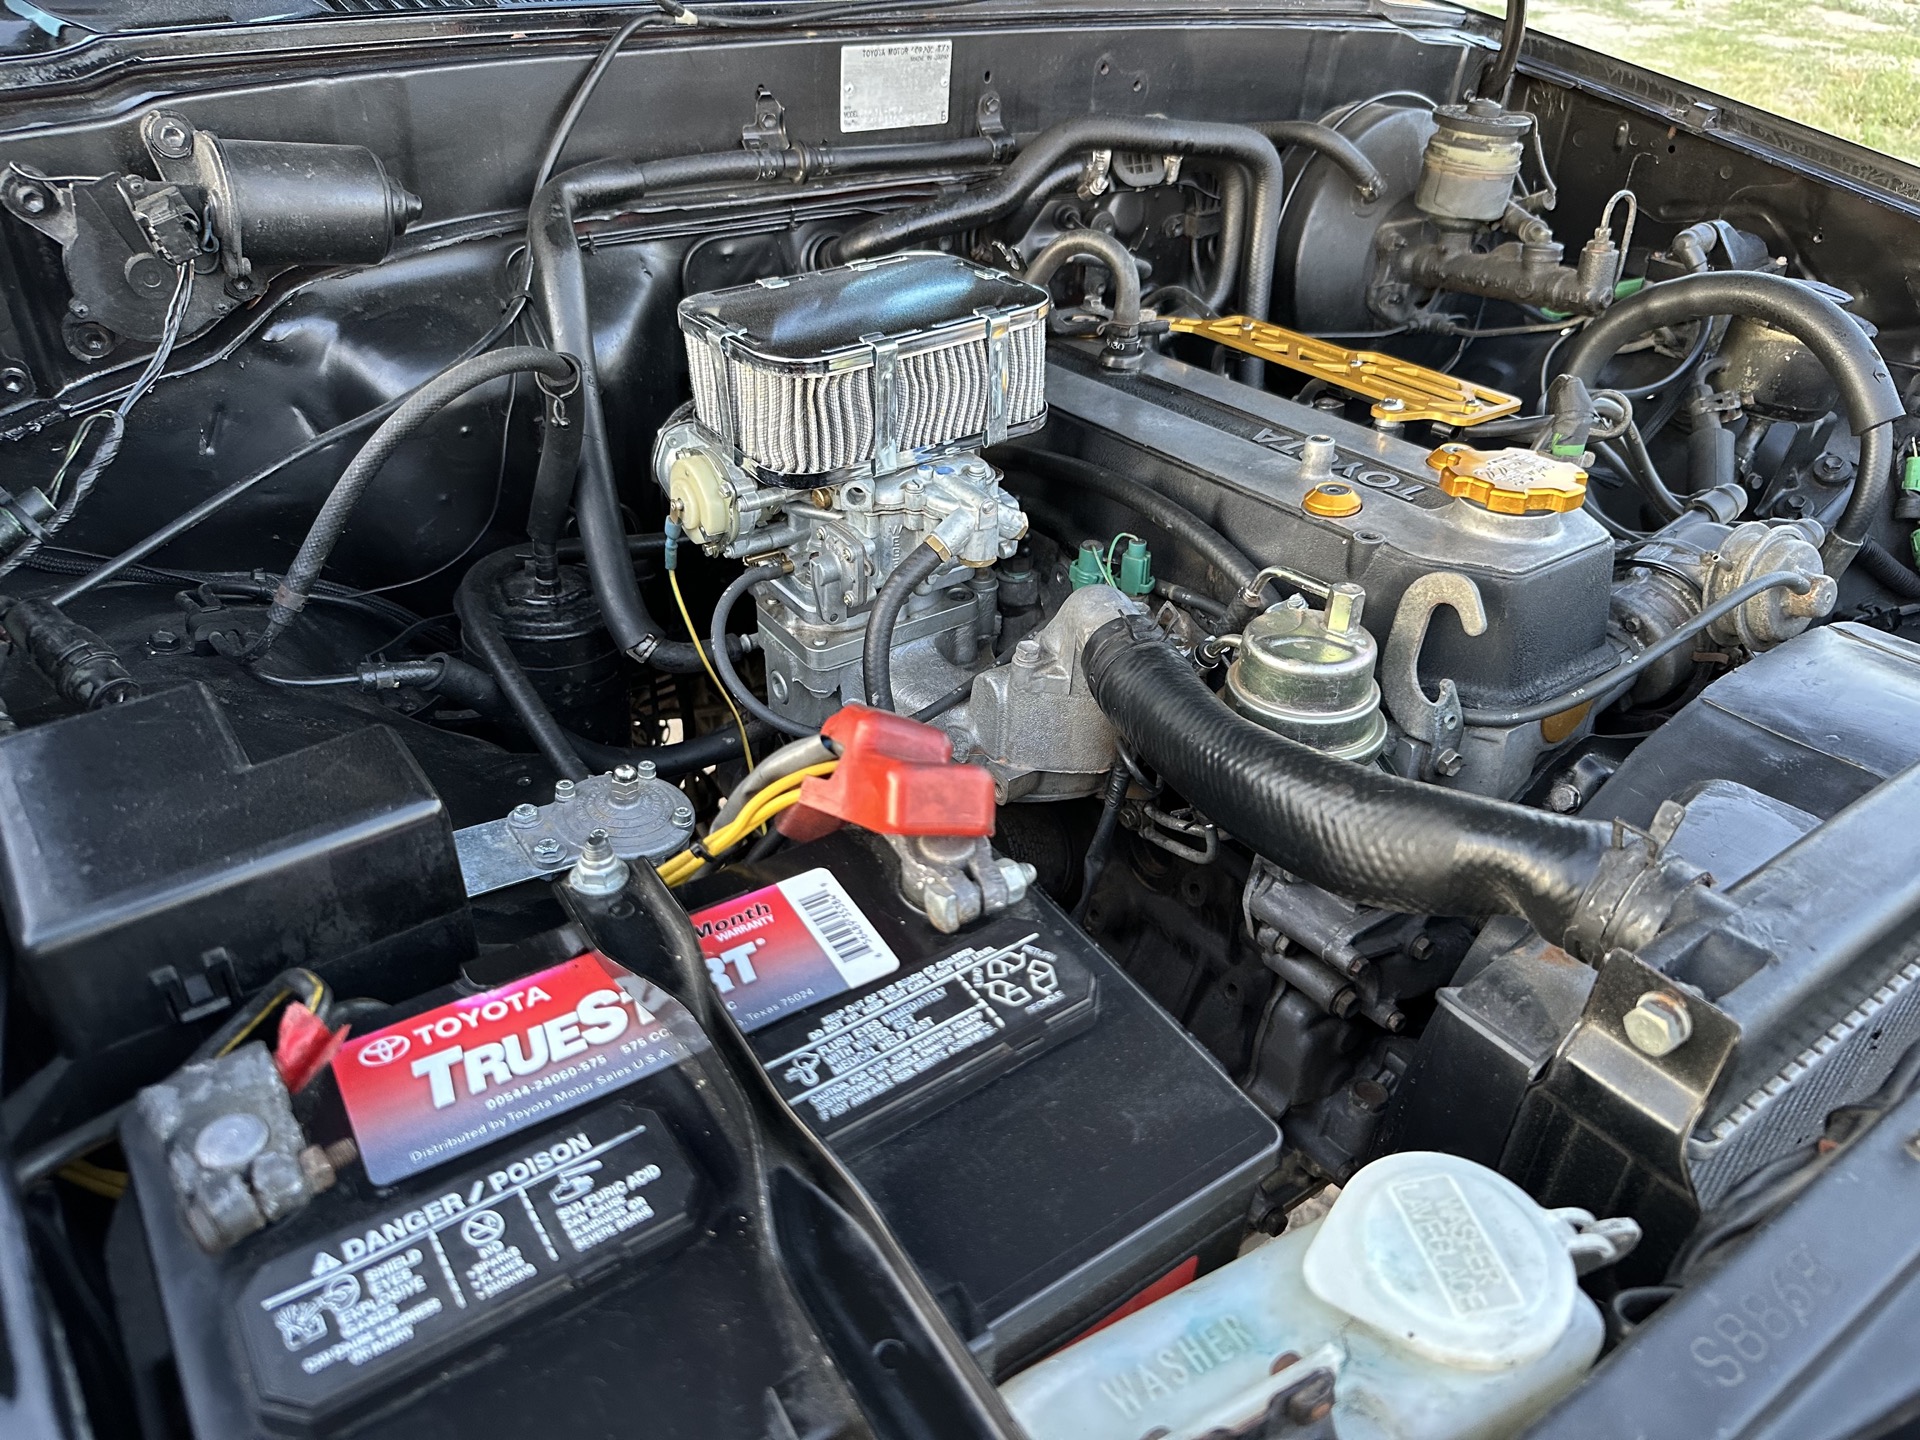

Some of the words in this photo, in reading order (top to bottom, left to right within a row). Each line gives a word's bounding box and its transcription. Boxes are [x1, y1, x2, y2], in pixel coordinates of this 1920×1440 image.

[714, 913, 775, 943] WARRANTY
[413, 986, 552, 1045] TOYOTA
[745, 1004, 780, 1021] Texas
[780, 987, 816, 1007] 75024
[816, 1033, 855, 1056] FLUSH
[851, 1019, 884, 1040] EYES
[880, 986, 948, 1027] IMMEDIATELY
[844, 999, 865, 1014] OUT
[821, 1045, 856, 1067] WITH
[892, 1013, 918, 1032] GET
[830, 1046, 881, 1077] MEDICAL
[877, 1031, 908, 1053] HELP
[905, 1016, 936, 1037] FAST
[485, 1054, 607, 1111] 00544-24060-575
[620, 1037, 648, 1054] 575
[410, 1124, 488, 1162] Distributed
[488, 1117, 507, 1130] by
[506, 1099, 553, 1122] Toyota
[553, 1082, 595, 1104] Motor
[596, 1066, 632, 1085] Sales
[487, 1132, 593, 1193] POISON
[555, 1180, 630, 1220] SULFURIC
[626, 1164, 662, 1191] ACID
[477, 1240, 505, 1259] NO
[1100, 1314, 1255, 1420] WASHER
